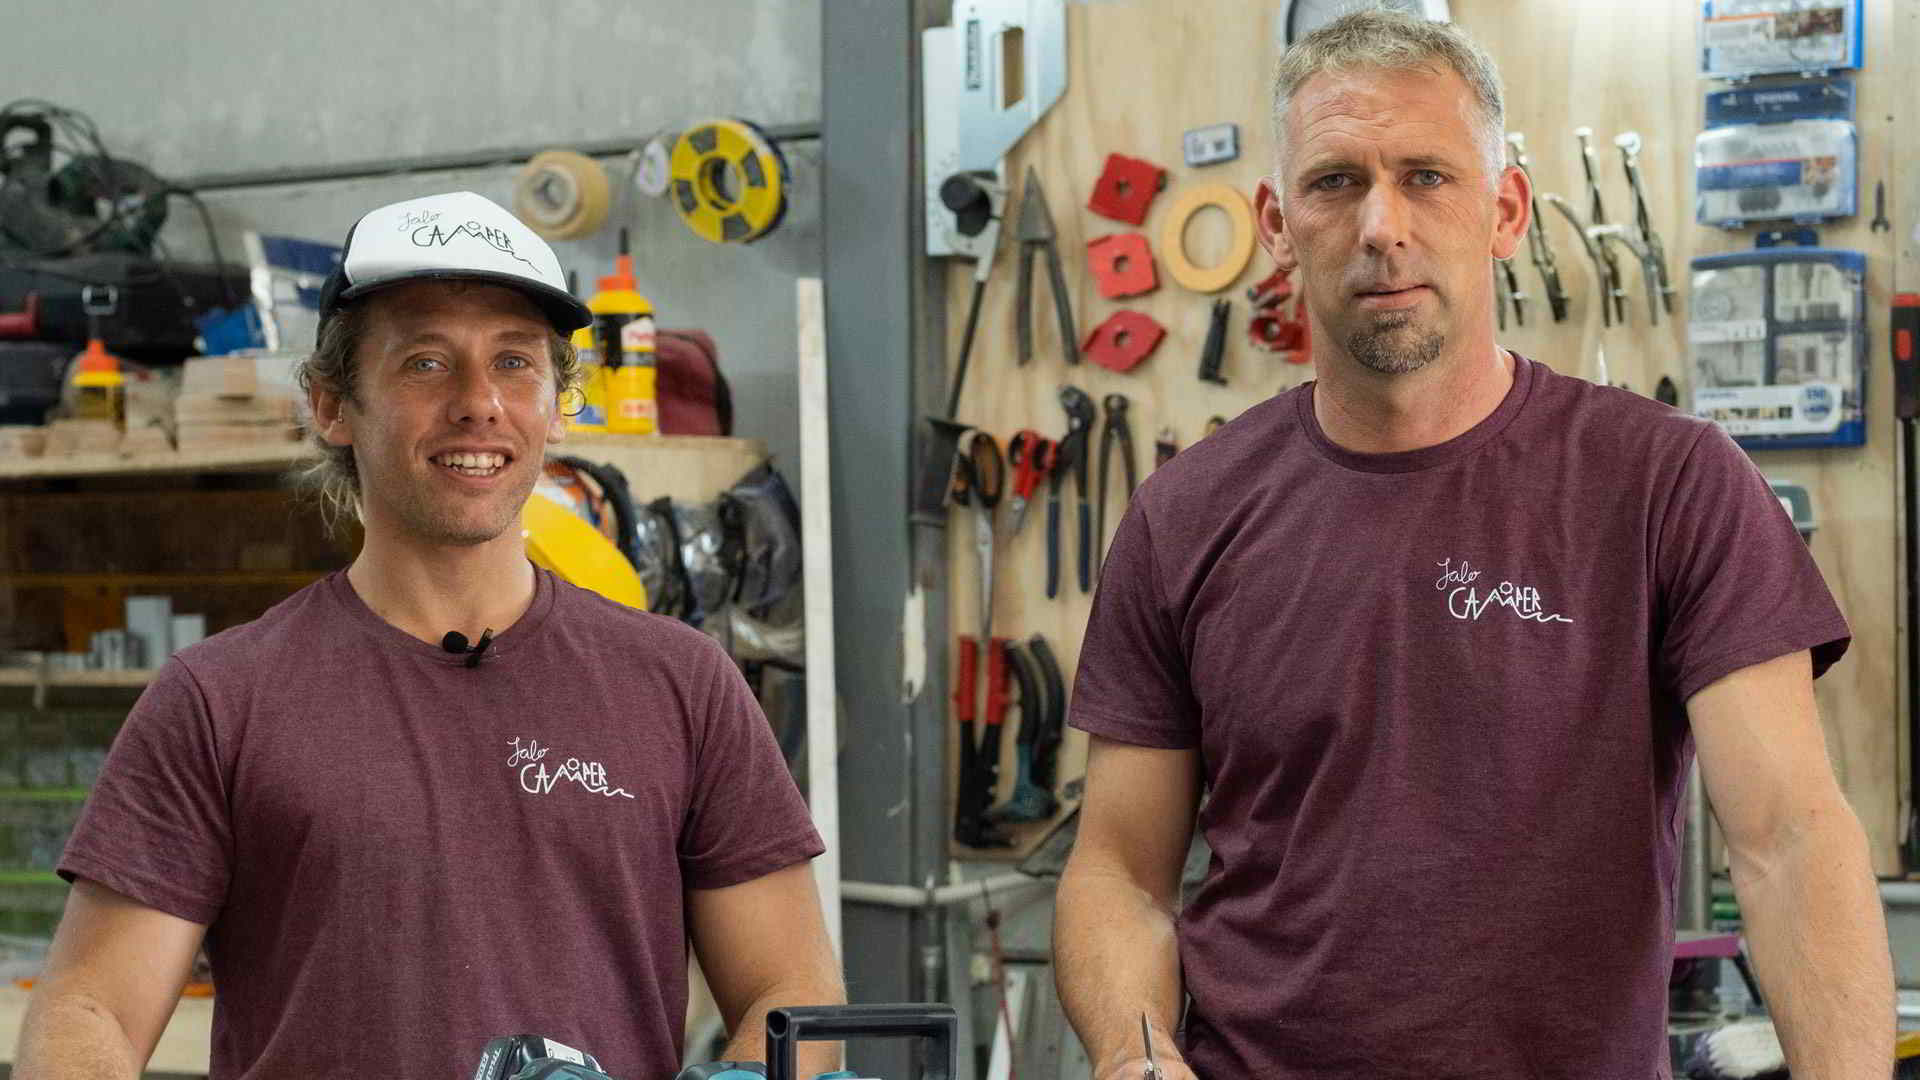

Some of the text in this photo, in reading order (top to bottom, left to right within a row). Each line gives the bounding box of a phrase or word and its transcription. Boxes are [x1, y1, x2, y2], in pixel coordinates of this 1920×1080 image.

[398, 209, 442, 231] Jalo
[411, 221, 526, 261] CAMPER
[1436, 557, 1482, 590] Jalo
[1448, 580, 1562, 622] CAMPER
[506, 736, 549, 767] Jalo
[520, 757, 623, 796] CAMPER
